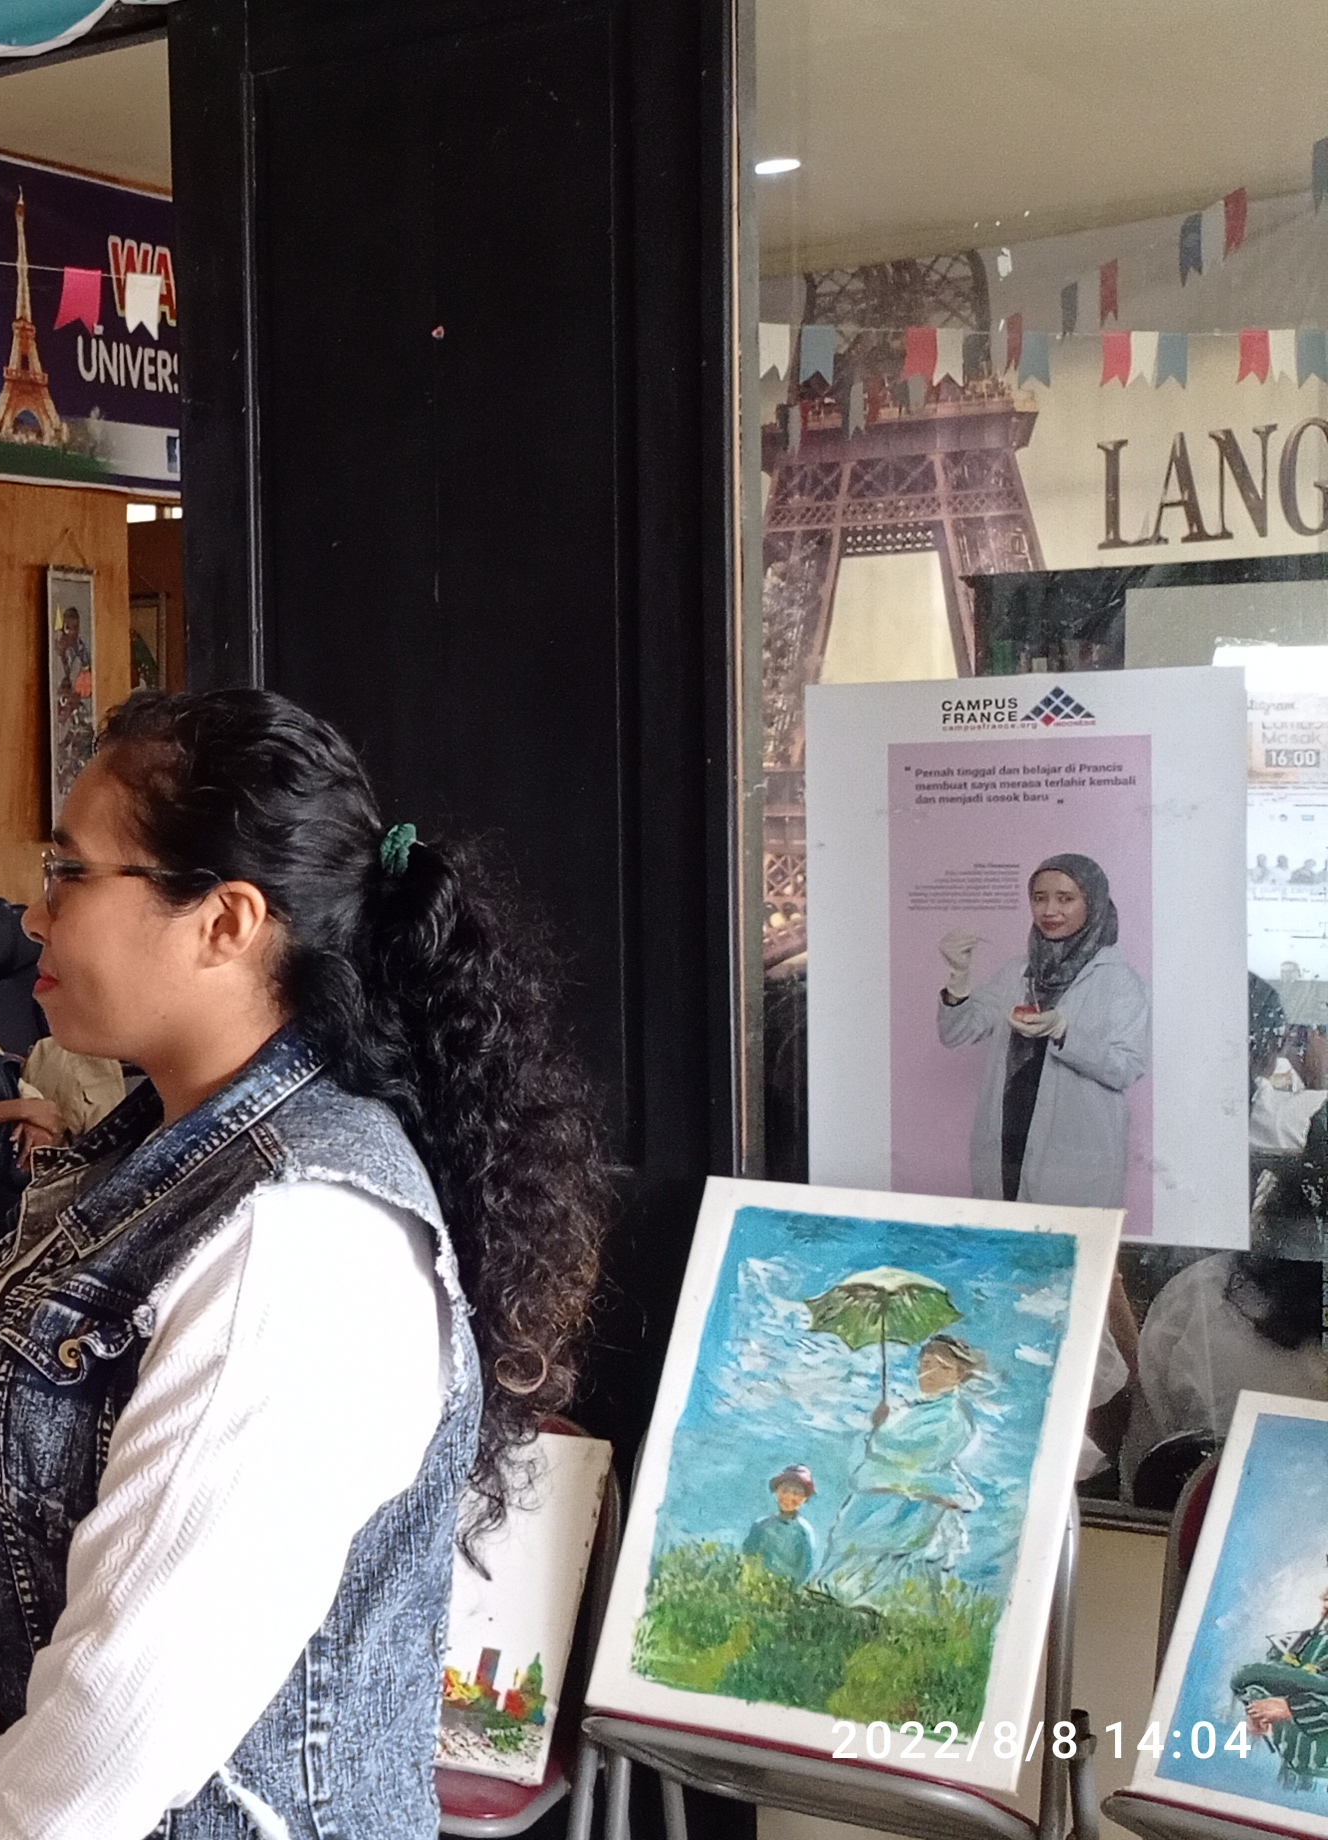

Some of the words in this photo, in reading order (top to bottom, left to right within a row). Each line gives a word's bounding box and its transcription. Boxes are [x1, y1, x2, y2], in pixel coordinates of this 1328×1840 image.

[1097, 416, 1328, 550] LANG
[941, 698, 1019, 713] CAMPUS
[941, 711, 1019, 724] FRANCE
[915, 768, 954, 778] Pernah
[957, 766, 996, 778] tinggal
[998, 766, 1020, 776] dan
[1022, 764, 1062, 776] belajar
[1064, 764, 1076, 774] di
[1078, 763, 1123, 774] Prancis
[915, 781, 967, 791] membuat
[970, 781, 996, 792] saya
[999, 780, 1041, 789] merasa
[1044, 778, 1086, 788] terlahir
[1089, 776, 1137, 786] kembali
[915, 794, 936, 805] dan
[938, 793, 983, 806] menjadi
[986, 792, 1020, 802] sosok
[1022, 791, 1049, 802] baru
